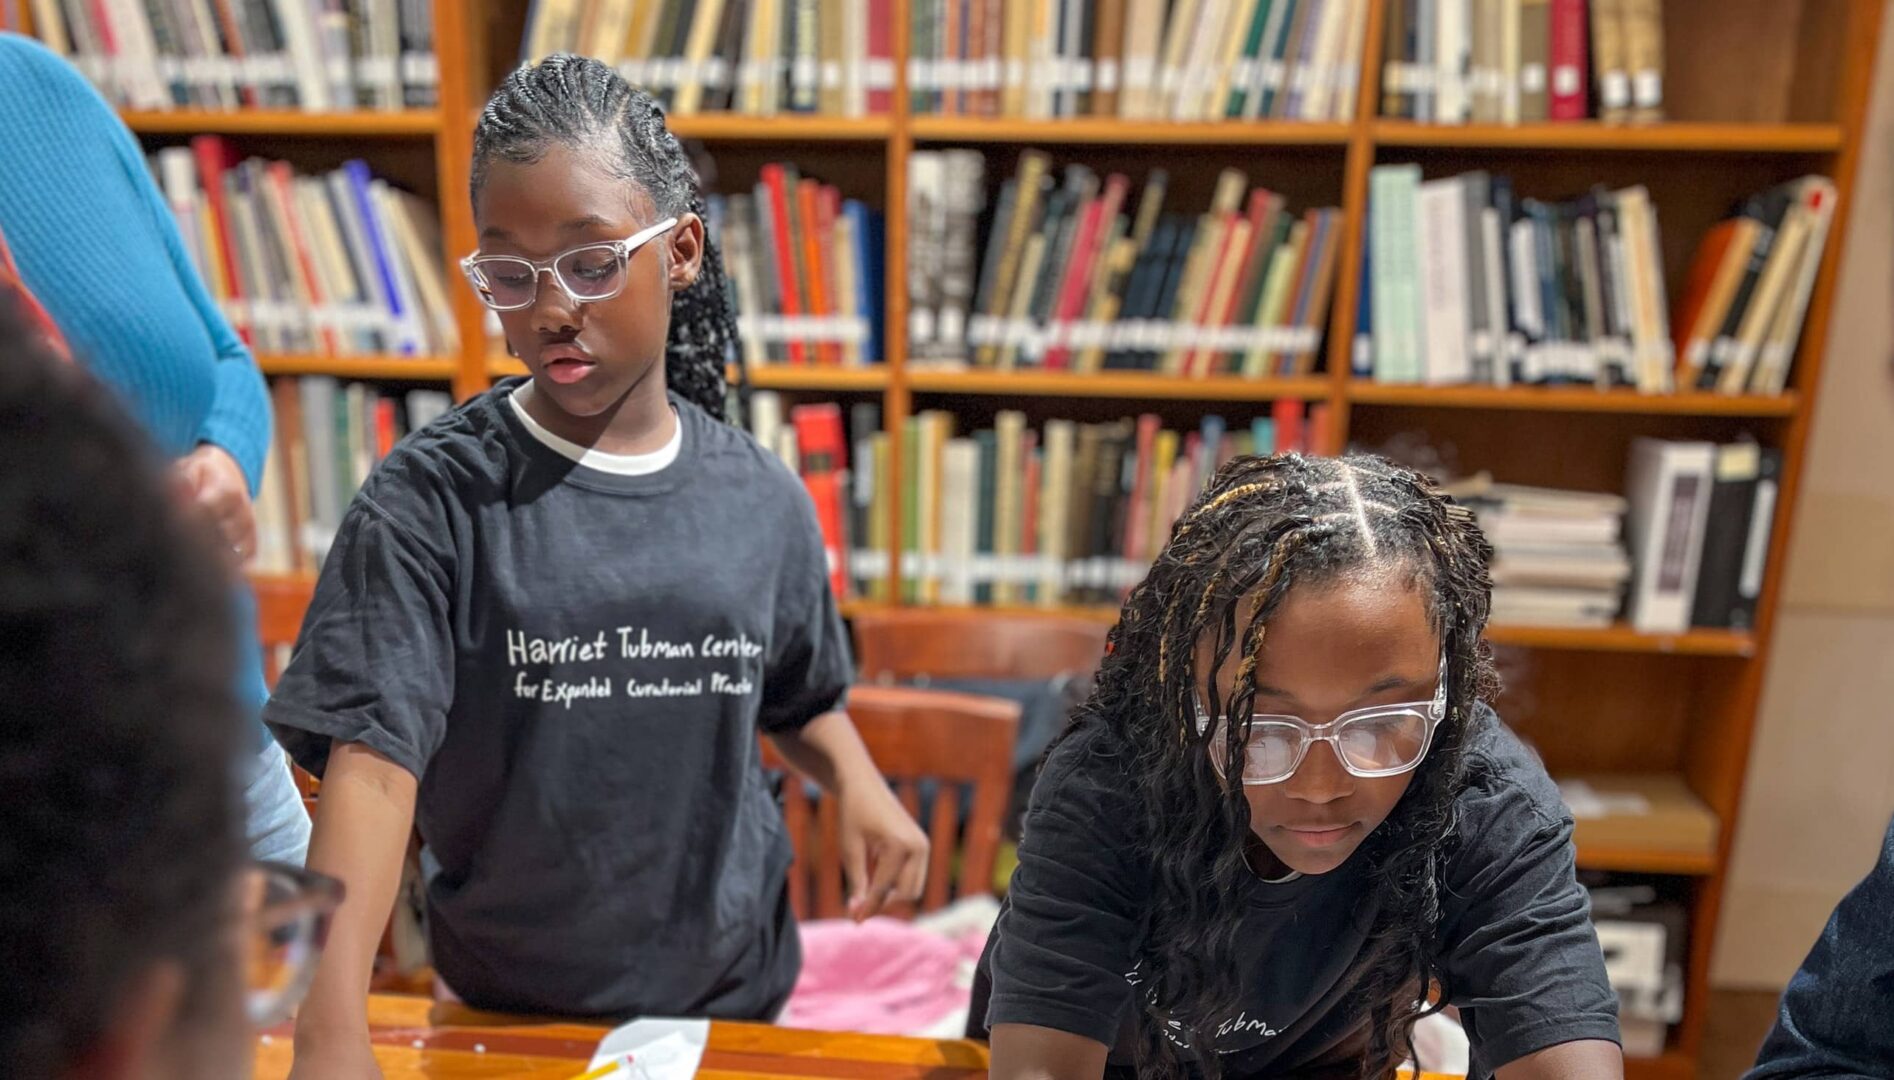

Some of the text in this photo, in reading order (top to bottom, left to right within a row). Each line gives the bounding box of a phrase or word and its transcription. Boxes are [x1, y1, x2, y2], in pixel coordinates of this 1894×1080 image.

[507, 626, 762, 666] Harriet Tubman Center
[514, 671, 539, 698] for
[541, 676, 612, 709] Expanded
[627, 677, 702, 697] Curatorial
[1215, 1011, 1289, 1038] Tubma
